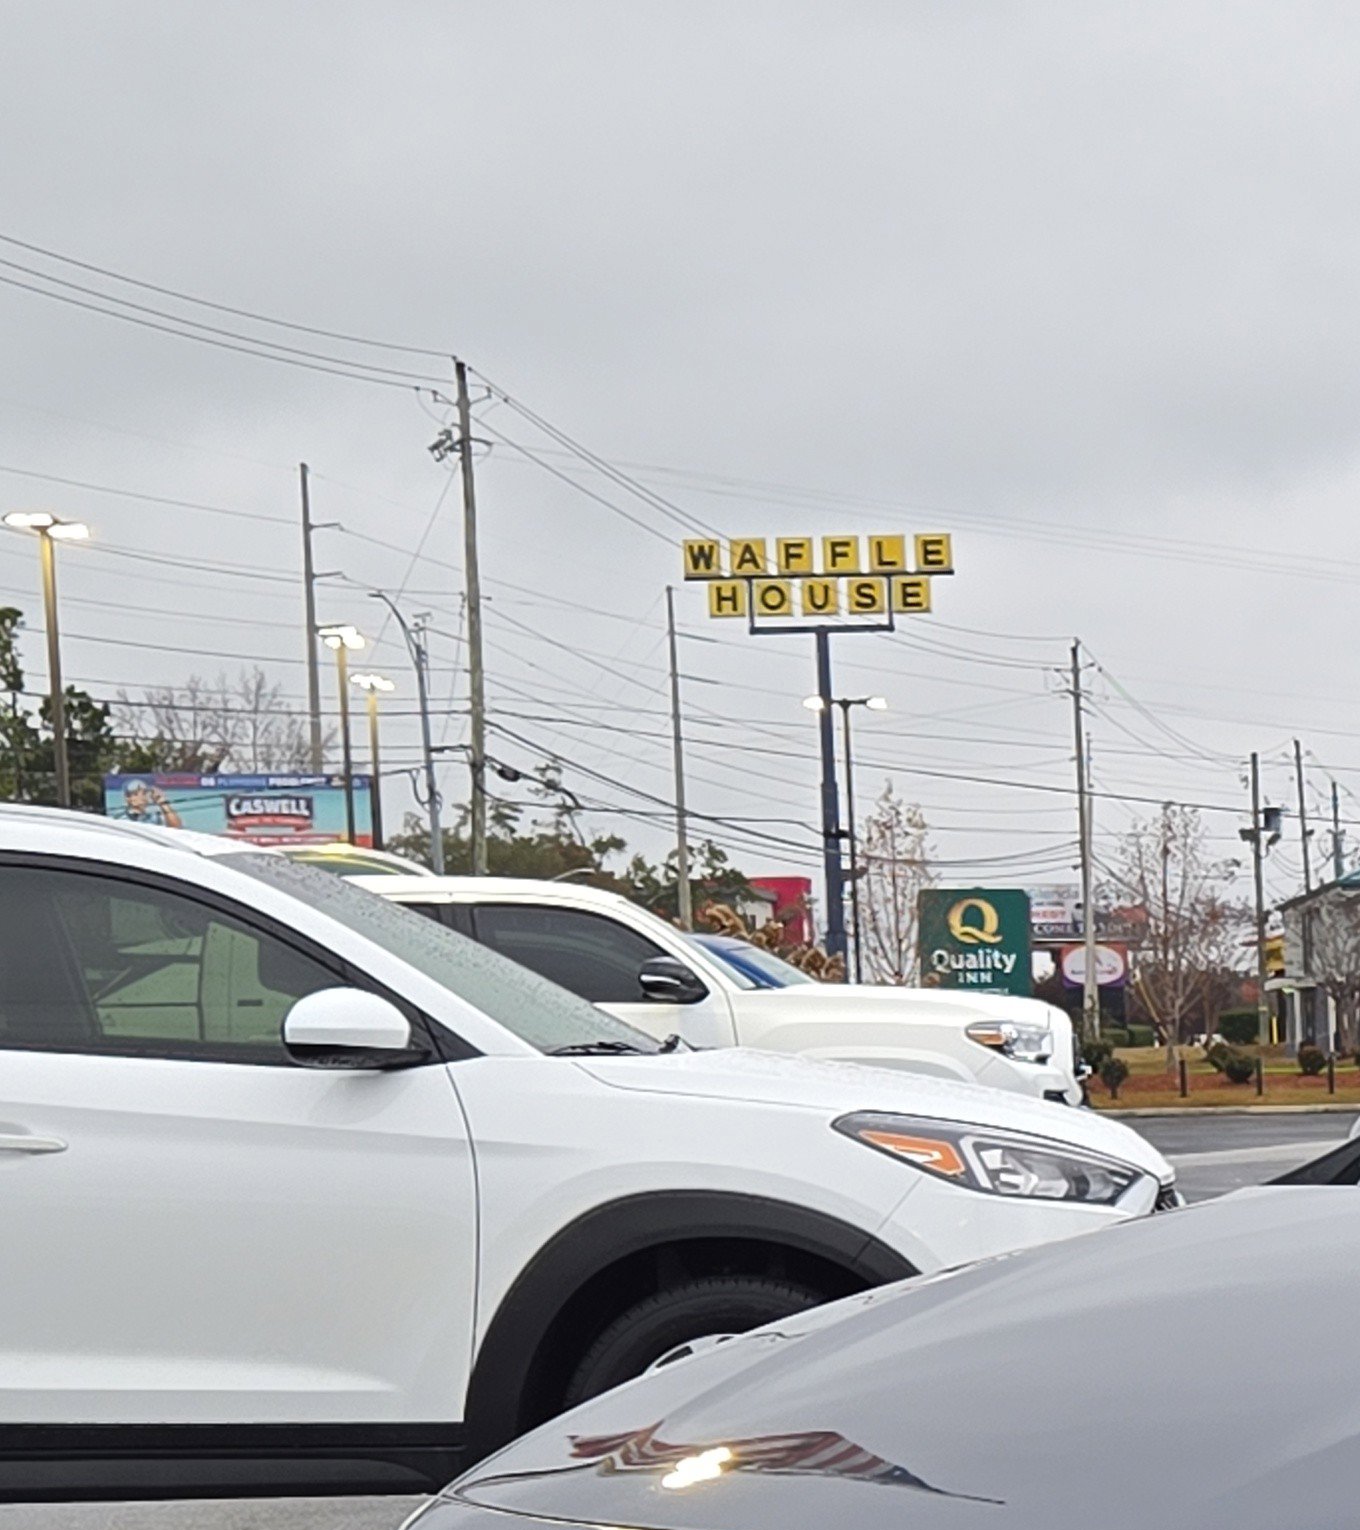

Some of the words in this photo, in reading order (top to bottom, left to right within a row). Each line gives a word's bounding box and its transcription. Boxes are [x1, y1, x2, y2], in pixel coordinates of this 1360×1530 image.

[687, 538, 945, 571] WAFFLE
[715, 582, 924, 613] HOUSE
[228, 798, 312, 816] CASWELL
[947, 898, 1003, 944] Q
[931, 947, 1017, 974] Quality
[957, 970, 993, 983] INN
